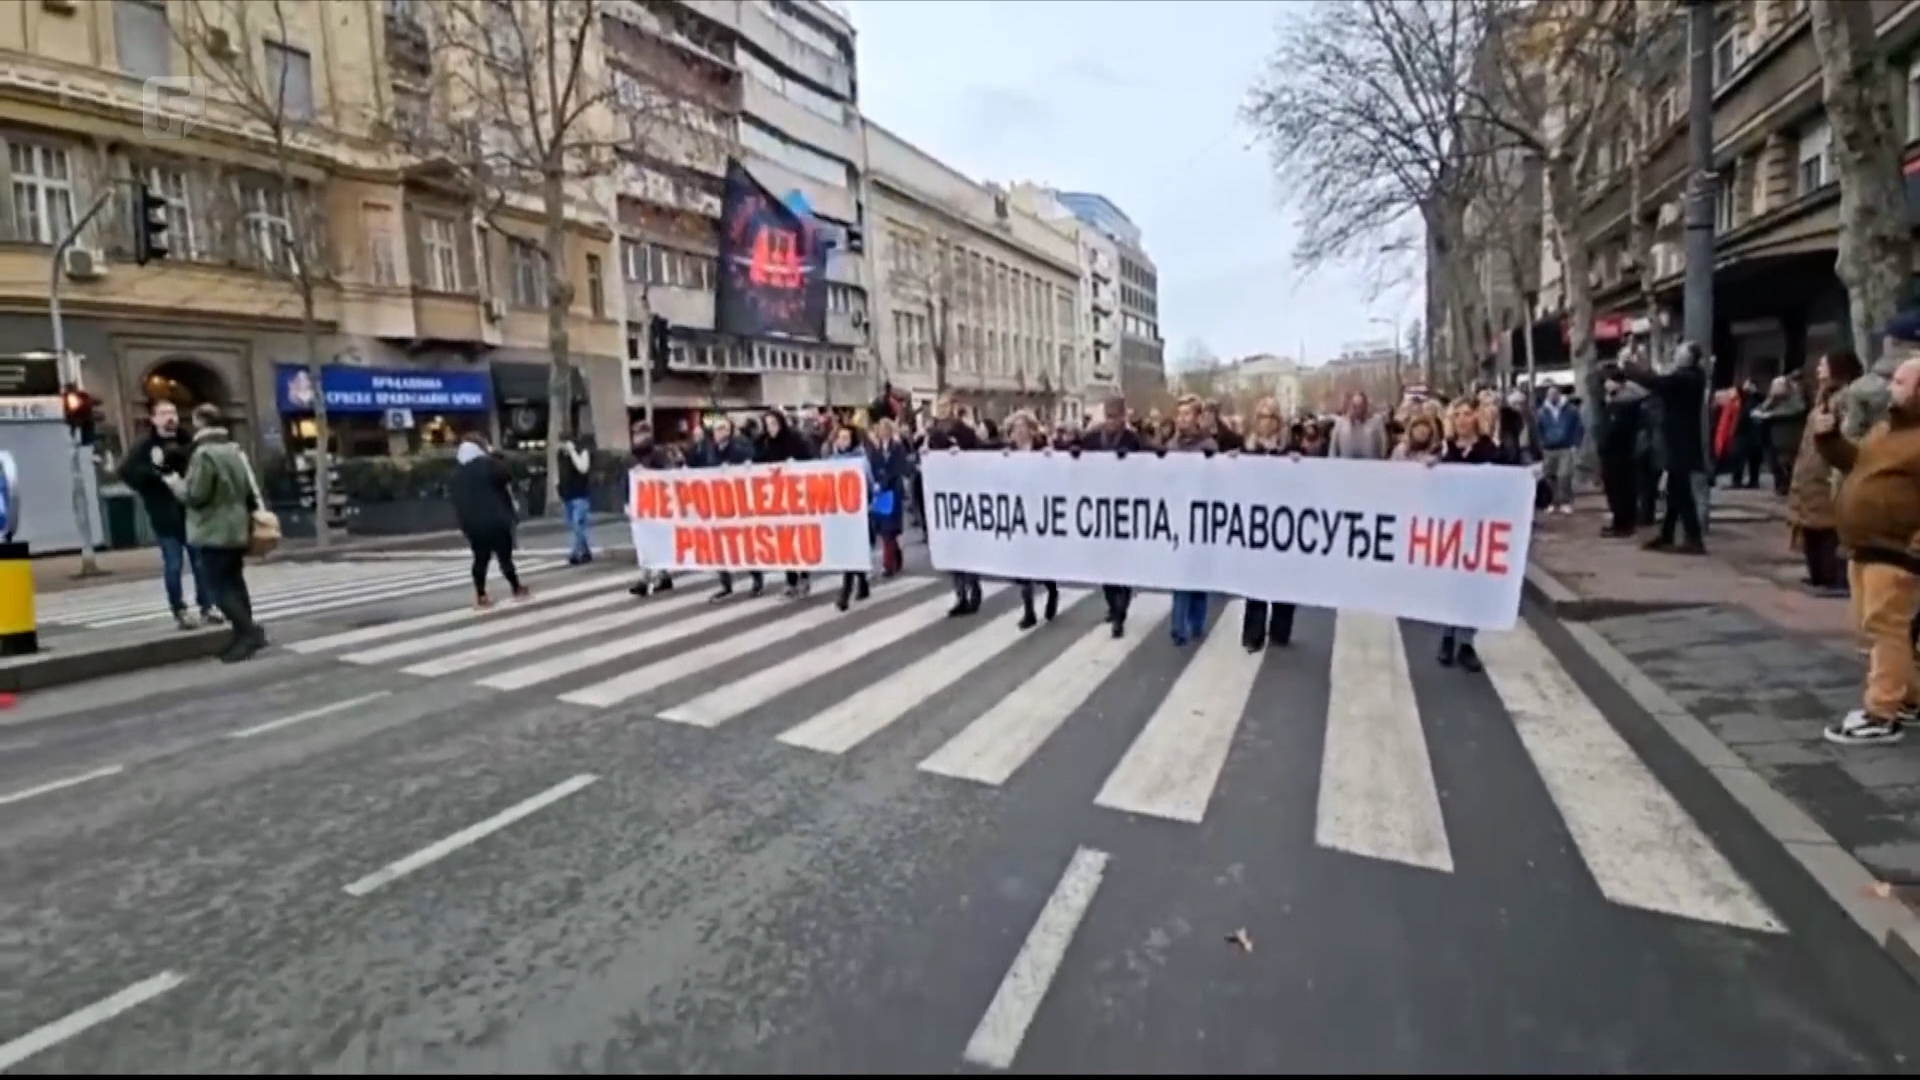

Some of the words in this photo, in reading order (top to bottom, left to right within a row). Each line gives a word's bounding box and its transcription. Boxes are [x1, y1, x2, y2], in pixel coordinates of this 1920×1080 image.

[637, 478, 673, 520] NE
[674, 467, 861, 520] PODLEŽEMO
[675, 523, 823, 566] PRITISKU
[933, 491, 1027, 541] ПРАВДА
[1035, 495, 1068, 537] ЈЕ
[1076, 495, 1181, 551] СЛЕПА,
[1189, 500, 1397, 563] ПРАВОСУЂЕ
[1408, 516, 1513, 574] НИЈЕ
